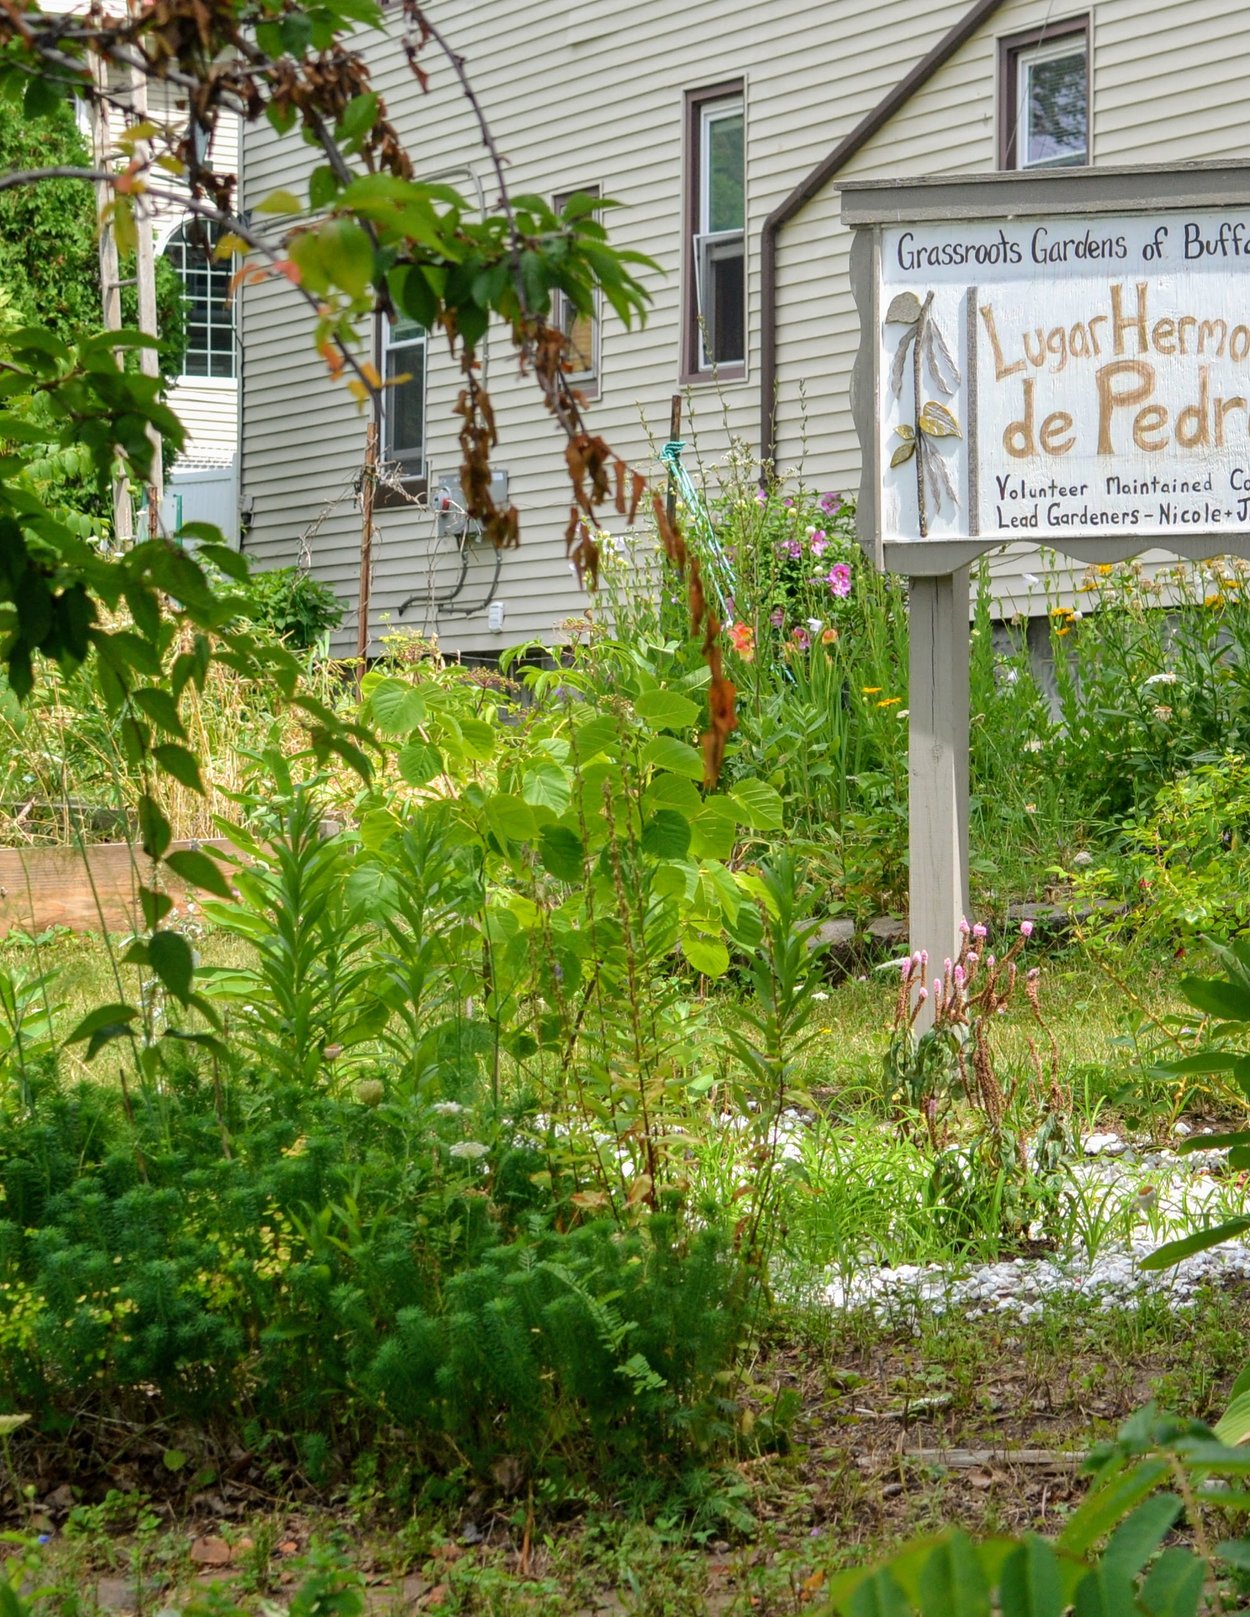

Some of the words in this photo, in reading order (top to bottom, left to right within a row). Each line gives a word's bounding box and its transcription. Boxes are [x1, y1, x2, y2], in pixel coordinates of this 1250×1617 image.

[898, 230, 1022, 270] Grassroots
[1031, 227, 1128, 264] Gardens
[1142, 226, 1168, 261] of
[979, 303, 1108, 382] Lugar
[1003, 377, 1076, 459] de
[996, 474, 1089, 501] Volunteer
[1106, 472, 1213, 496] Maintained
[996, 503, 1039, 529] Lead
